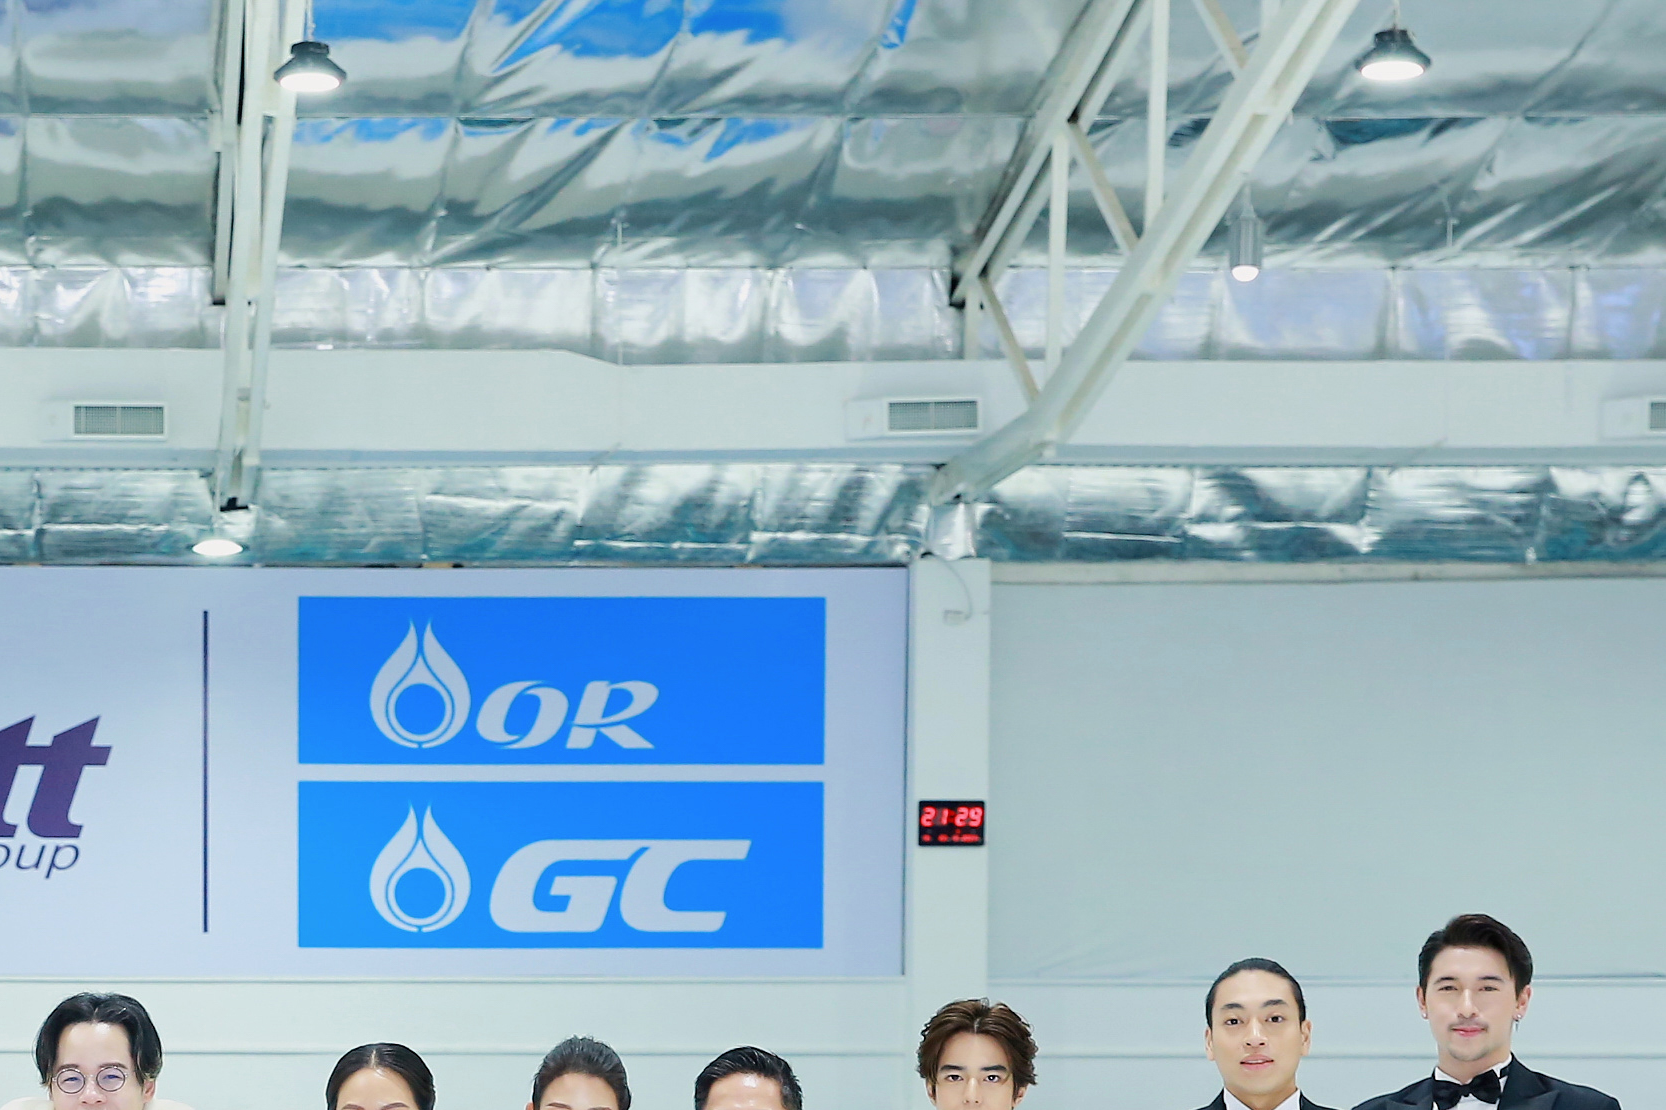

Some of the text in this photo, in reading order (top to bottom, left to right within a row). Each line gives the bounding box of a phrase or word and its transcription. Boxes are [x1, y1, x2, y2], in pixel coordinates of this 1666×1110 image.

[475, 679, 660, 750] OR
[920, 806, 984, 828] 21:29
[488, 838, 753, 933] GC
